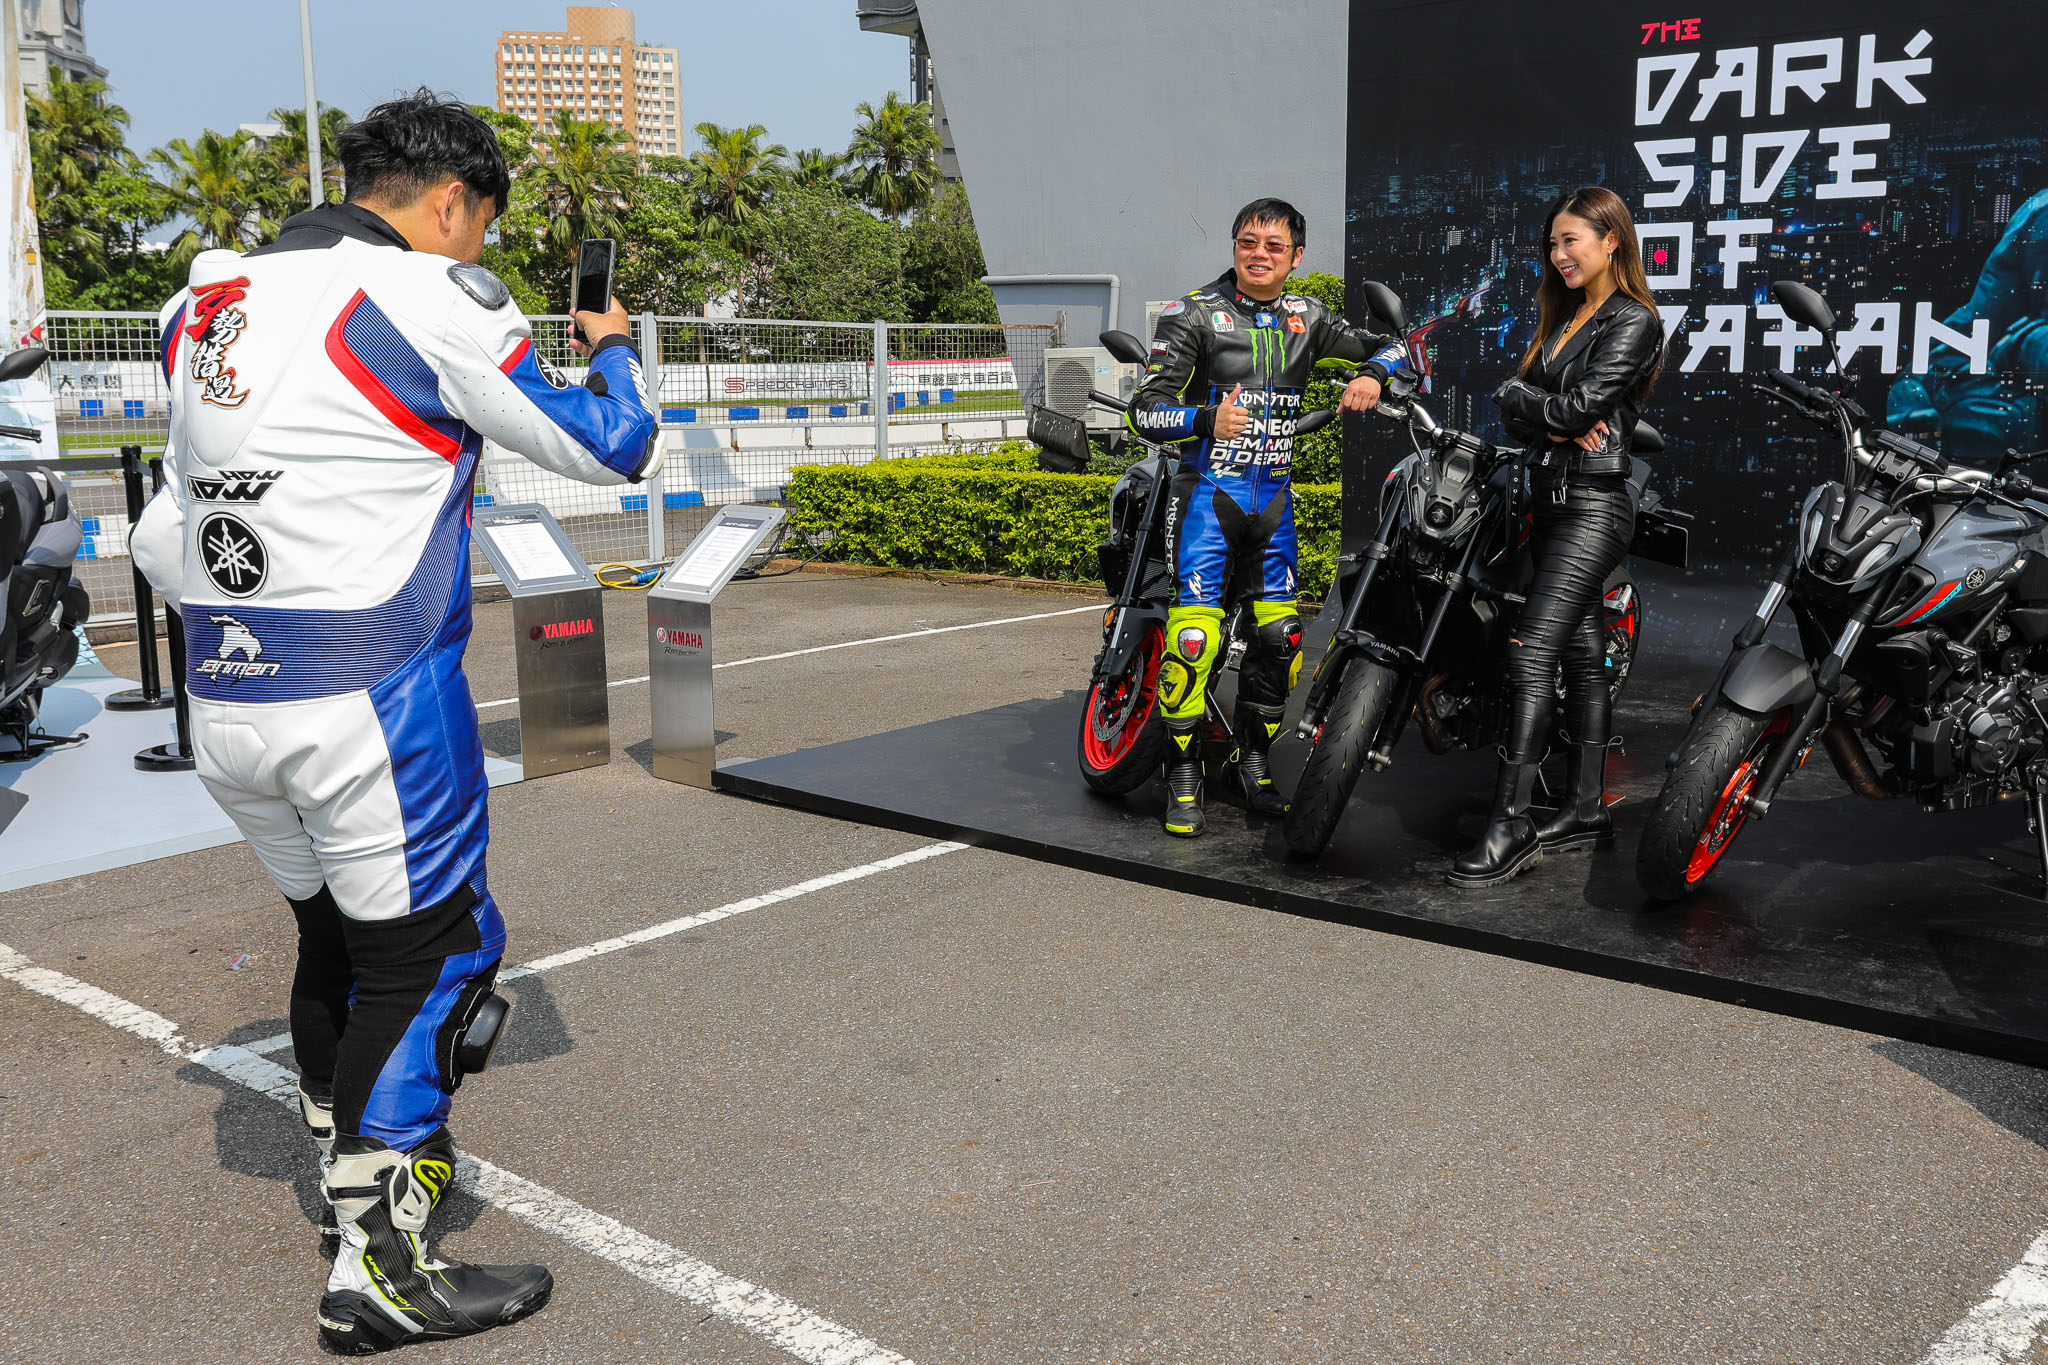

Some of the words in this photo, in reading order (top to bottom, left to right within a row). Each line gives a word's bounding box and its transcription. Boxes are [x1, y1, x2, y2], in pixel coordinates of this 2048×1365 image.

[1641, 18, 1701, 44] THE
[1635, 29, 1933, 126] DARK
[1635, 218, 1773, 290] OF
[1136, 409, 1186, 429] YAMAHA
[1241, 418, 1298, 436] ENEOS
[1213, 436, 1293, 451] SEMAKIN
[542, 618, 594, 639] YAMAHA
[666, 629, 704, 649] YAMAHA
[1370, 641, 1400, 659] YAMAHA
